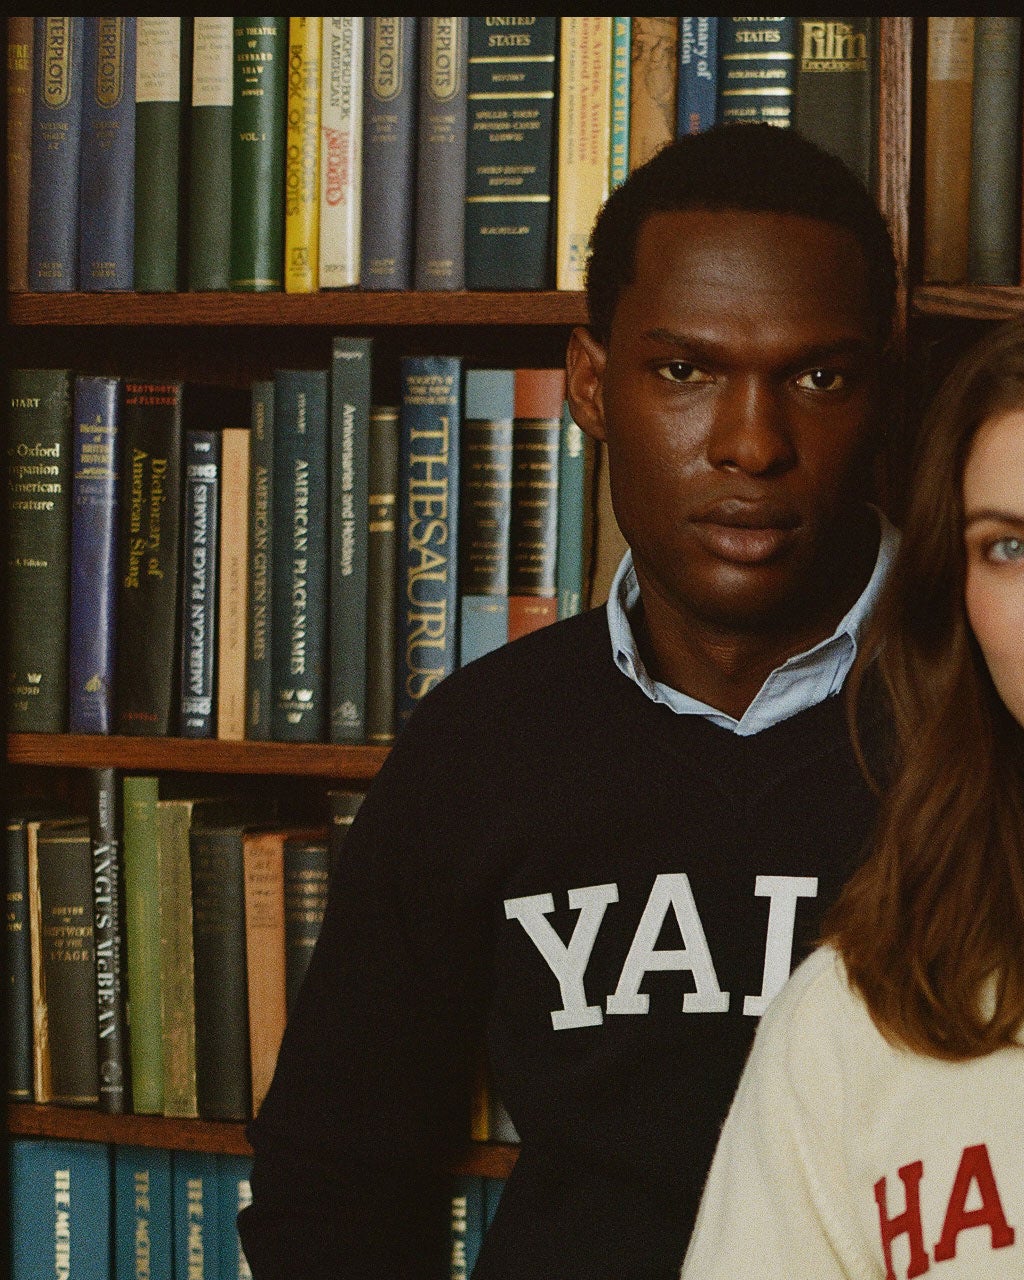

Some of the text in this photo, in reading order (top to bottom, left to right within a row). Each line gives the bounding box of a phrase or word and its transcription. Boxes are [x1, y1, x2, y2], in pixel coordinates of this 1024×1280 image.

[329, 34, 342, 107] AMERICAN
[488, 34, 532, 47] STATES
[697, 61, 711, 80] of
[735, 31, 781, 43] STATES
[801, 21, 867, 60] Film
[286, 44, 303, 217] BOOK OF QUOTES
[17, 443, 60, 458] Oxford
[340, 404, 357, 576] Anniversaries and Holidays
[124, 448, 149, 589] American Slang
[146, 458, 167, 580] Dictionary of
[293, 459, 309, 551] AMERICAN
[188, 484, 207, 695] AMERICAN PLACE NAMES
[253, 466, 268, 660] AMERICAN GIVEN NAMES
[405, 416, 450, 700] THESAURUS
[93, 842, 116, 1039] ANGUS McBEAN
[503, 872, 819, 1031] YAL
[54, 1169, 71, 1206] THE
[134, 1170, 151, 1212] THE
[187, 1177, 203, 1218] THE
